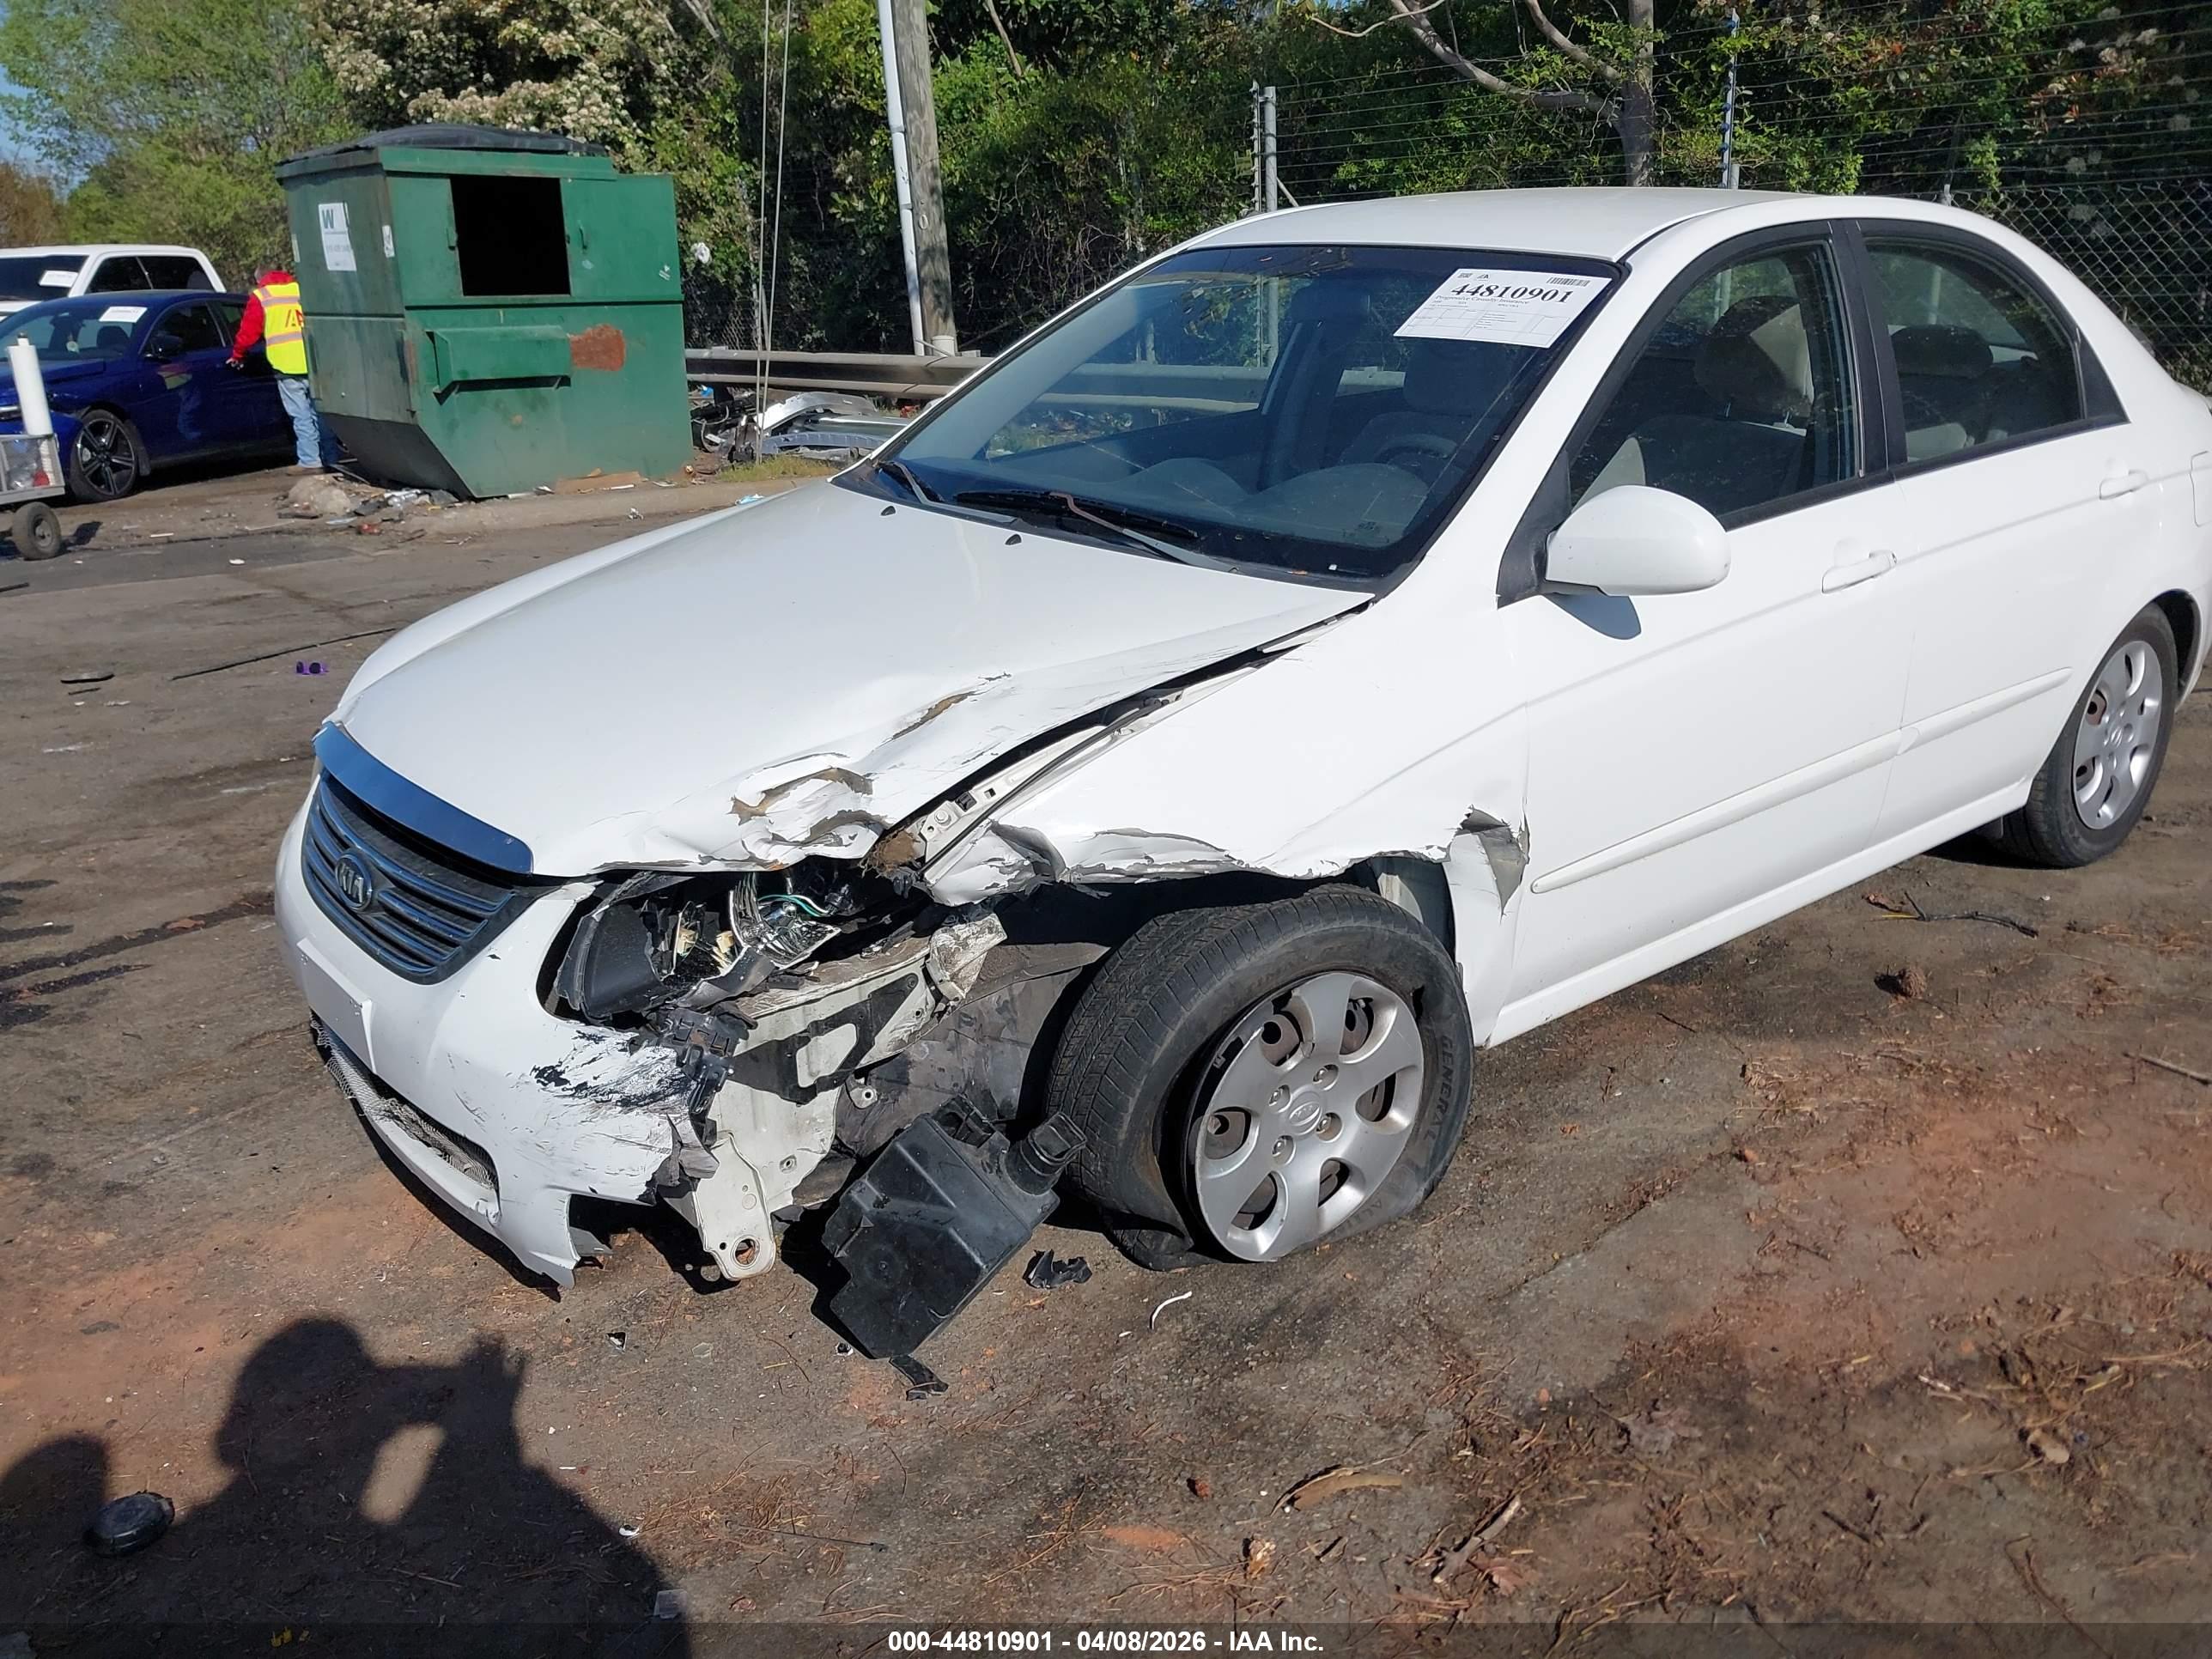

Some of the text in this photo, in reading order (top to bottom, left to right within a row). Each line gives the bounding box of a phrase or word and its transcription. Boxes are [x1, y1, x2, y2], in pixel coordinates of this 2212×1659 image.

[1450, 283, 1574, 304] 44810901
[339, 862, 364, 903] KIA
[1424, 1035, 1455, 1141] GENERAL
